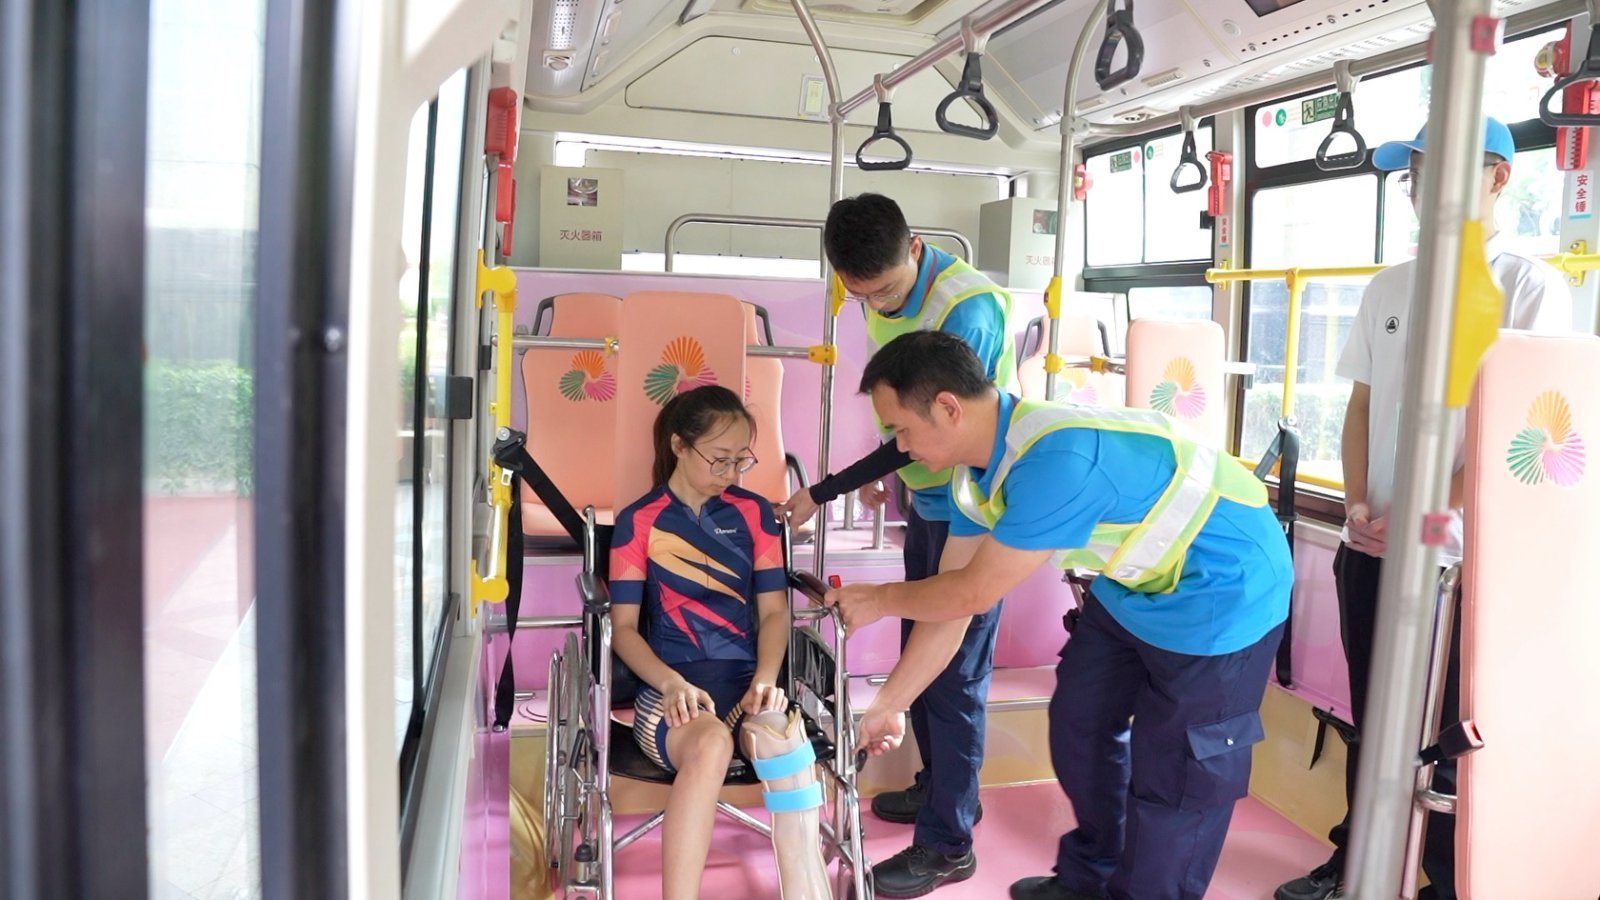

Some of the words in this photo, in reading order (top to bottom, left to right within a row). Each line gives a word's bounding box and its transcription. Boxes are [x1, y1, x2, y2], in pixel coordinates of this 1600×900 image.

[1575, 174, 1588, 213] 安全锤
[559, 229, 603, 242] 灭火器箱
